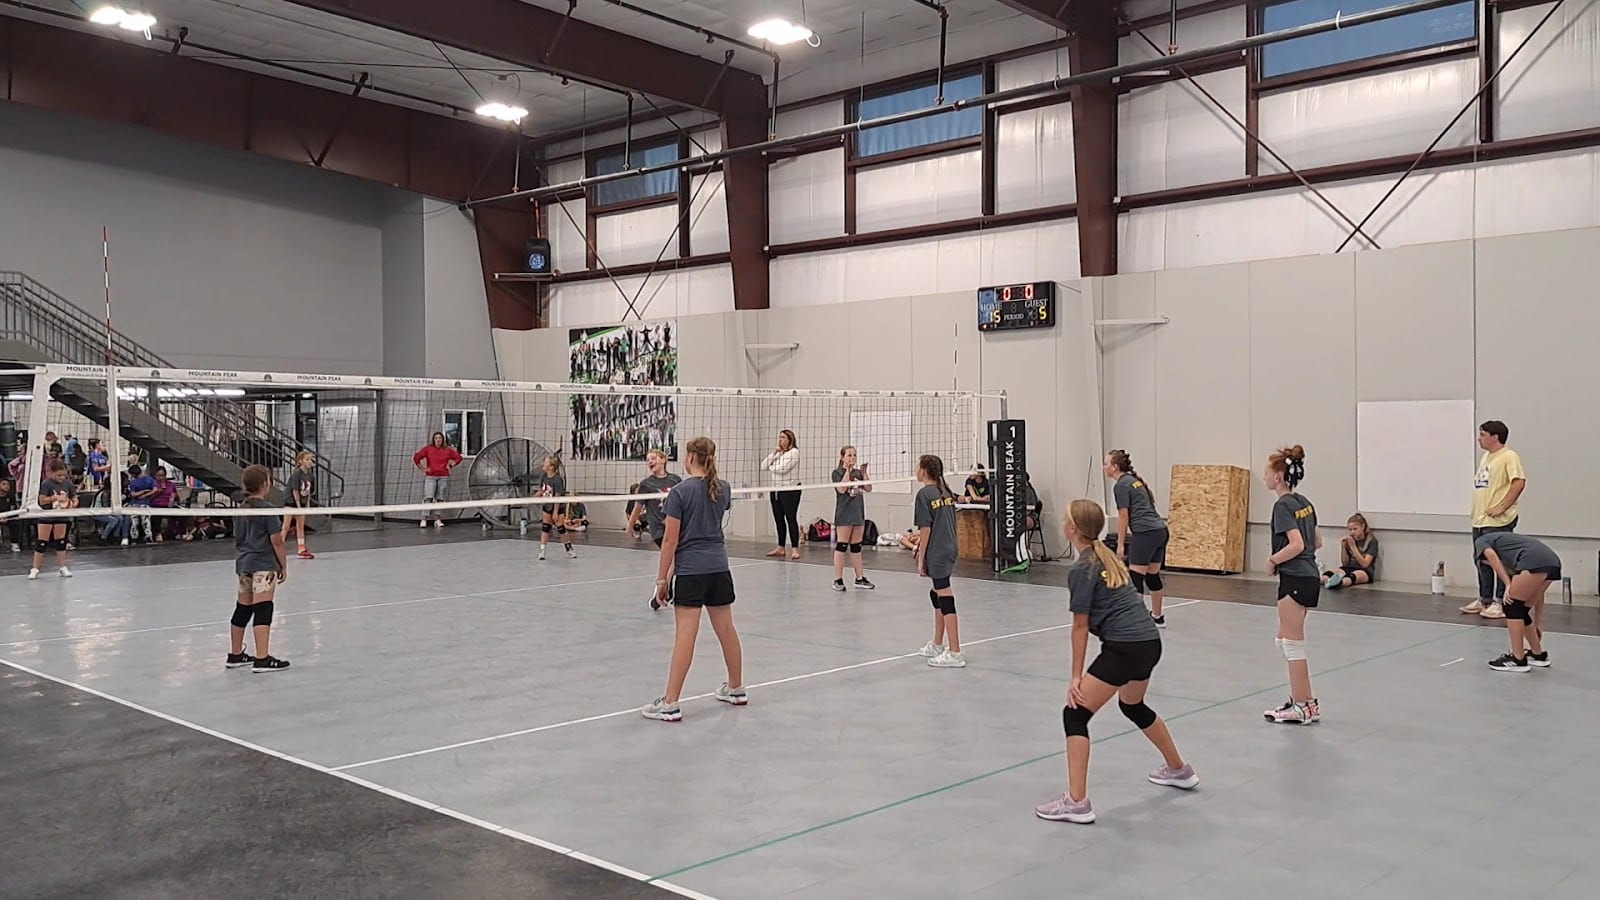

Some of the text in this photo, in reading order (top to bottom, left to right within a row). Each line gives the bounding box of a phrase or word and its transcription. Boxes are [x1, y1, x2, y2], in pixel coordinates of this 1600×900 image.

[980, 302, 1003, 312] HOME
[1025, 298, 1048, 308] GUEST
[1003, 313, 1025, 321] PERIOD
[1039, 305, 1047, 320] 5
[66, 365, 104, 373] MOUNTAIN
[1009, 425, 1016, 438] 1
[1005, 441, 1015, 538] MOUNTAIN PEAK
